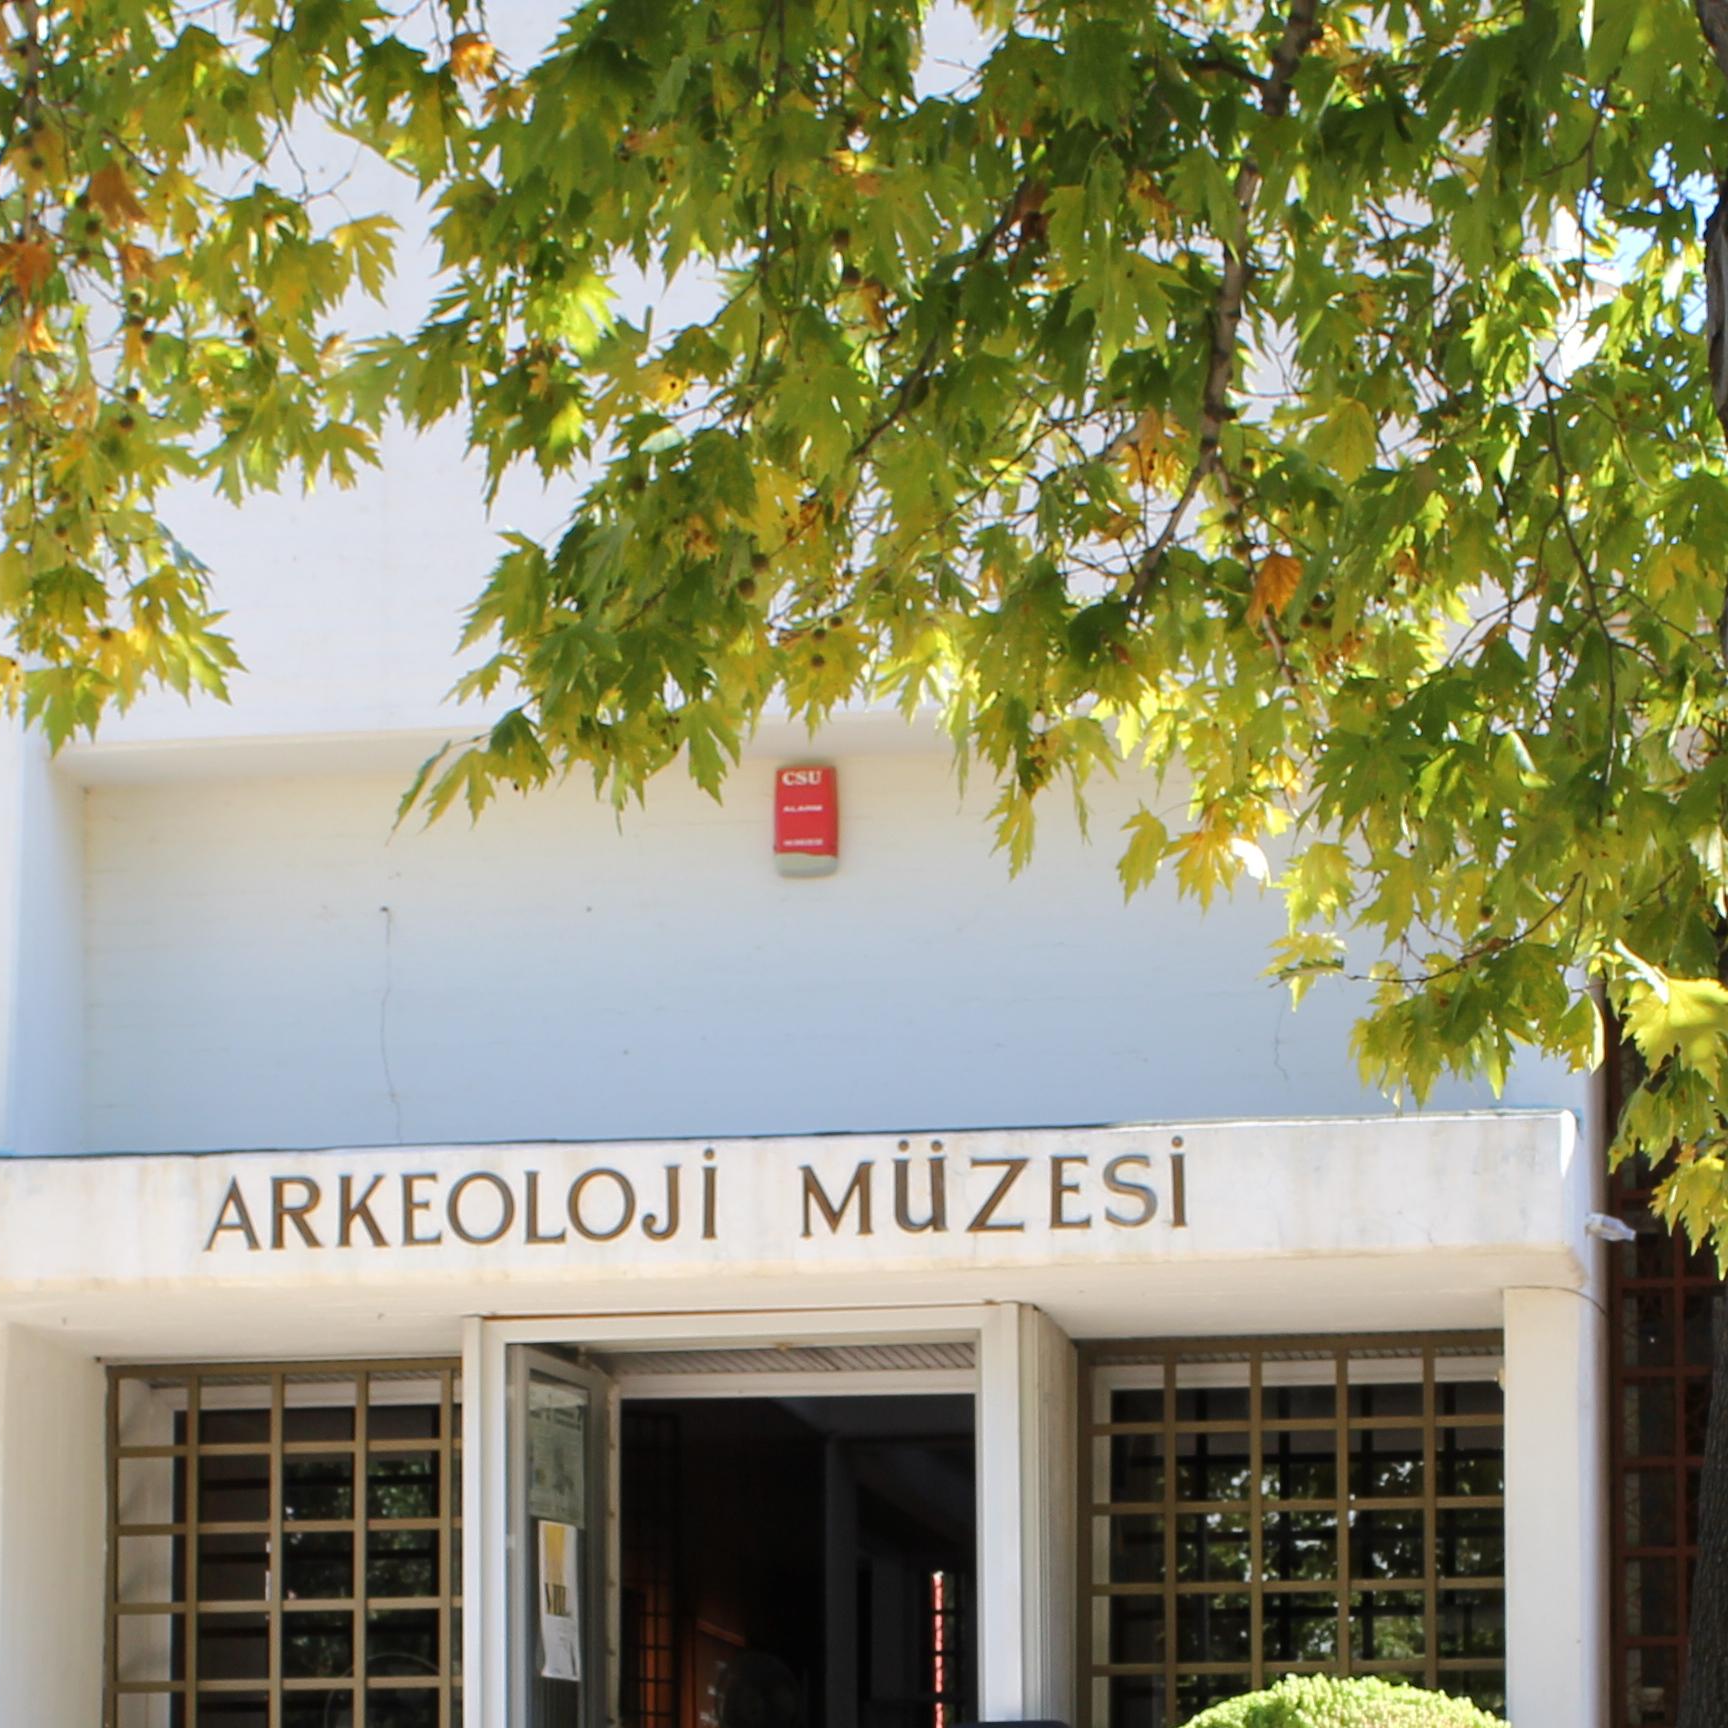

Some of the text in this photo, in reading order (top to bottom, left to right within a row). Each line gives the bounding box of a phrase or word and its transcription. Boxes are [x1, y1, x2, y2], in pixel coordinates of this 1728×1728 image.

[782, 770, 822, 786] CSU
[204, 1135, 1189, 1252] ARKEOLOJİ MÜZESİ
